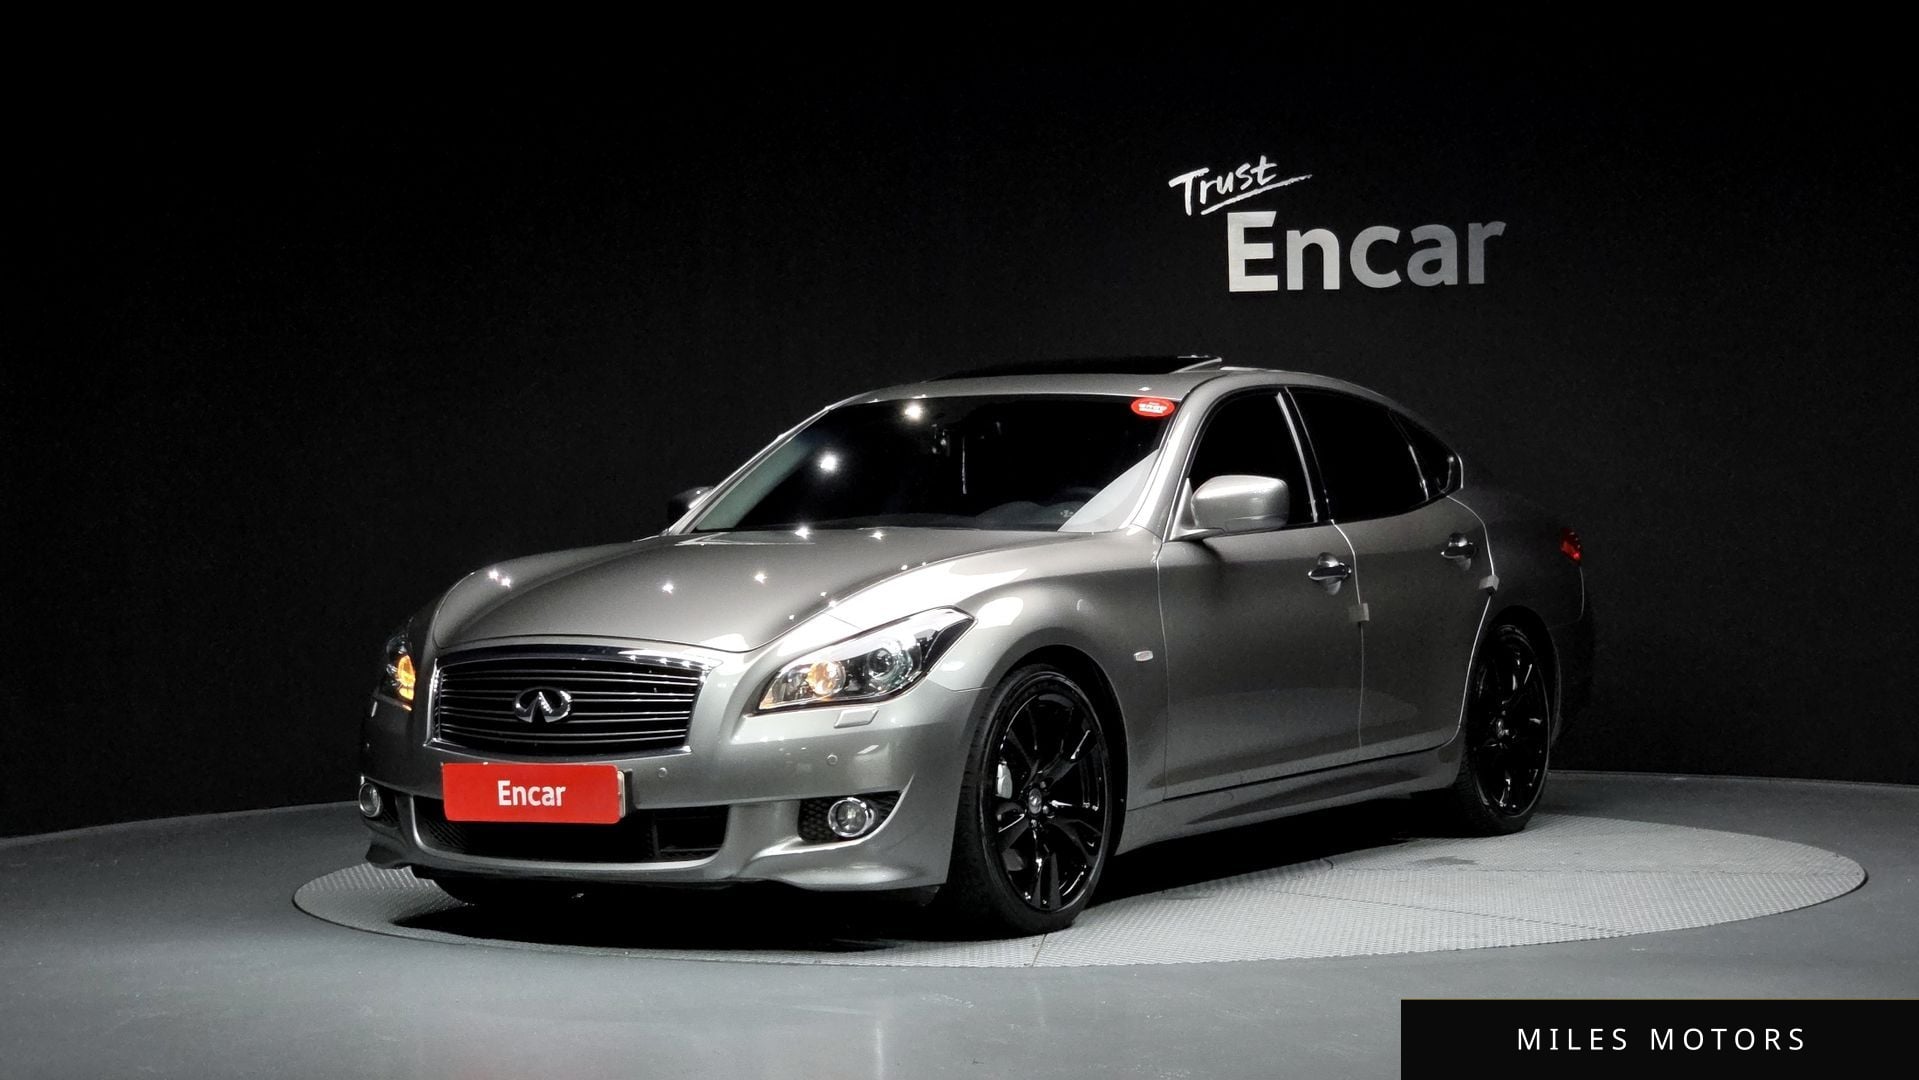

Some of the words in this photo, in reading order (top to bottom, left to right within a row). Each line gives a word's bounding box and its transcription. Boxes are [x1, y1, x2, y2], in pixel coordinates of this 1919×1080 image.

[1168, 155, 1278, 216] Trust
[1227, 210, 1506, 292] Encar
[498, 780, 566, 806] Encar
